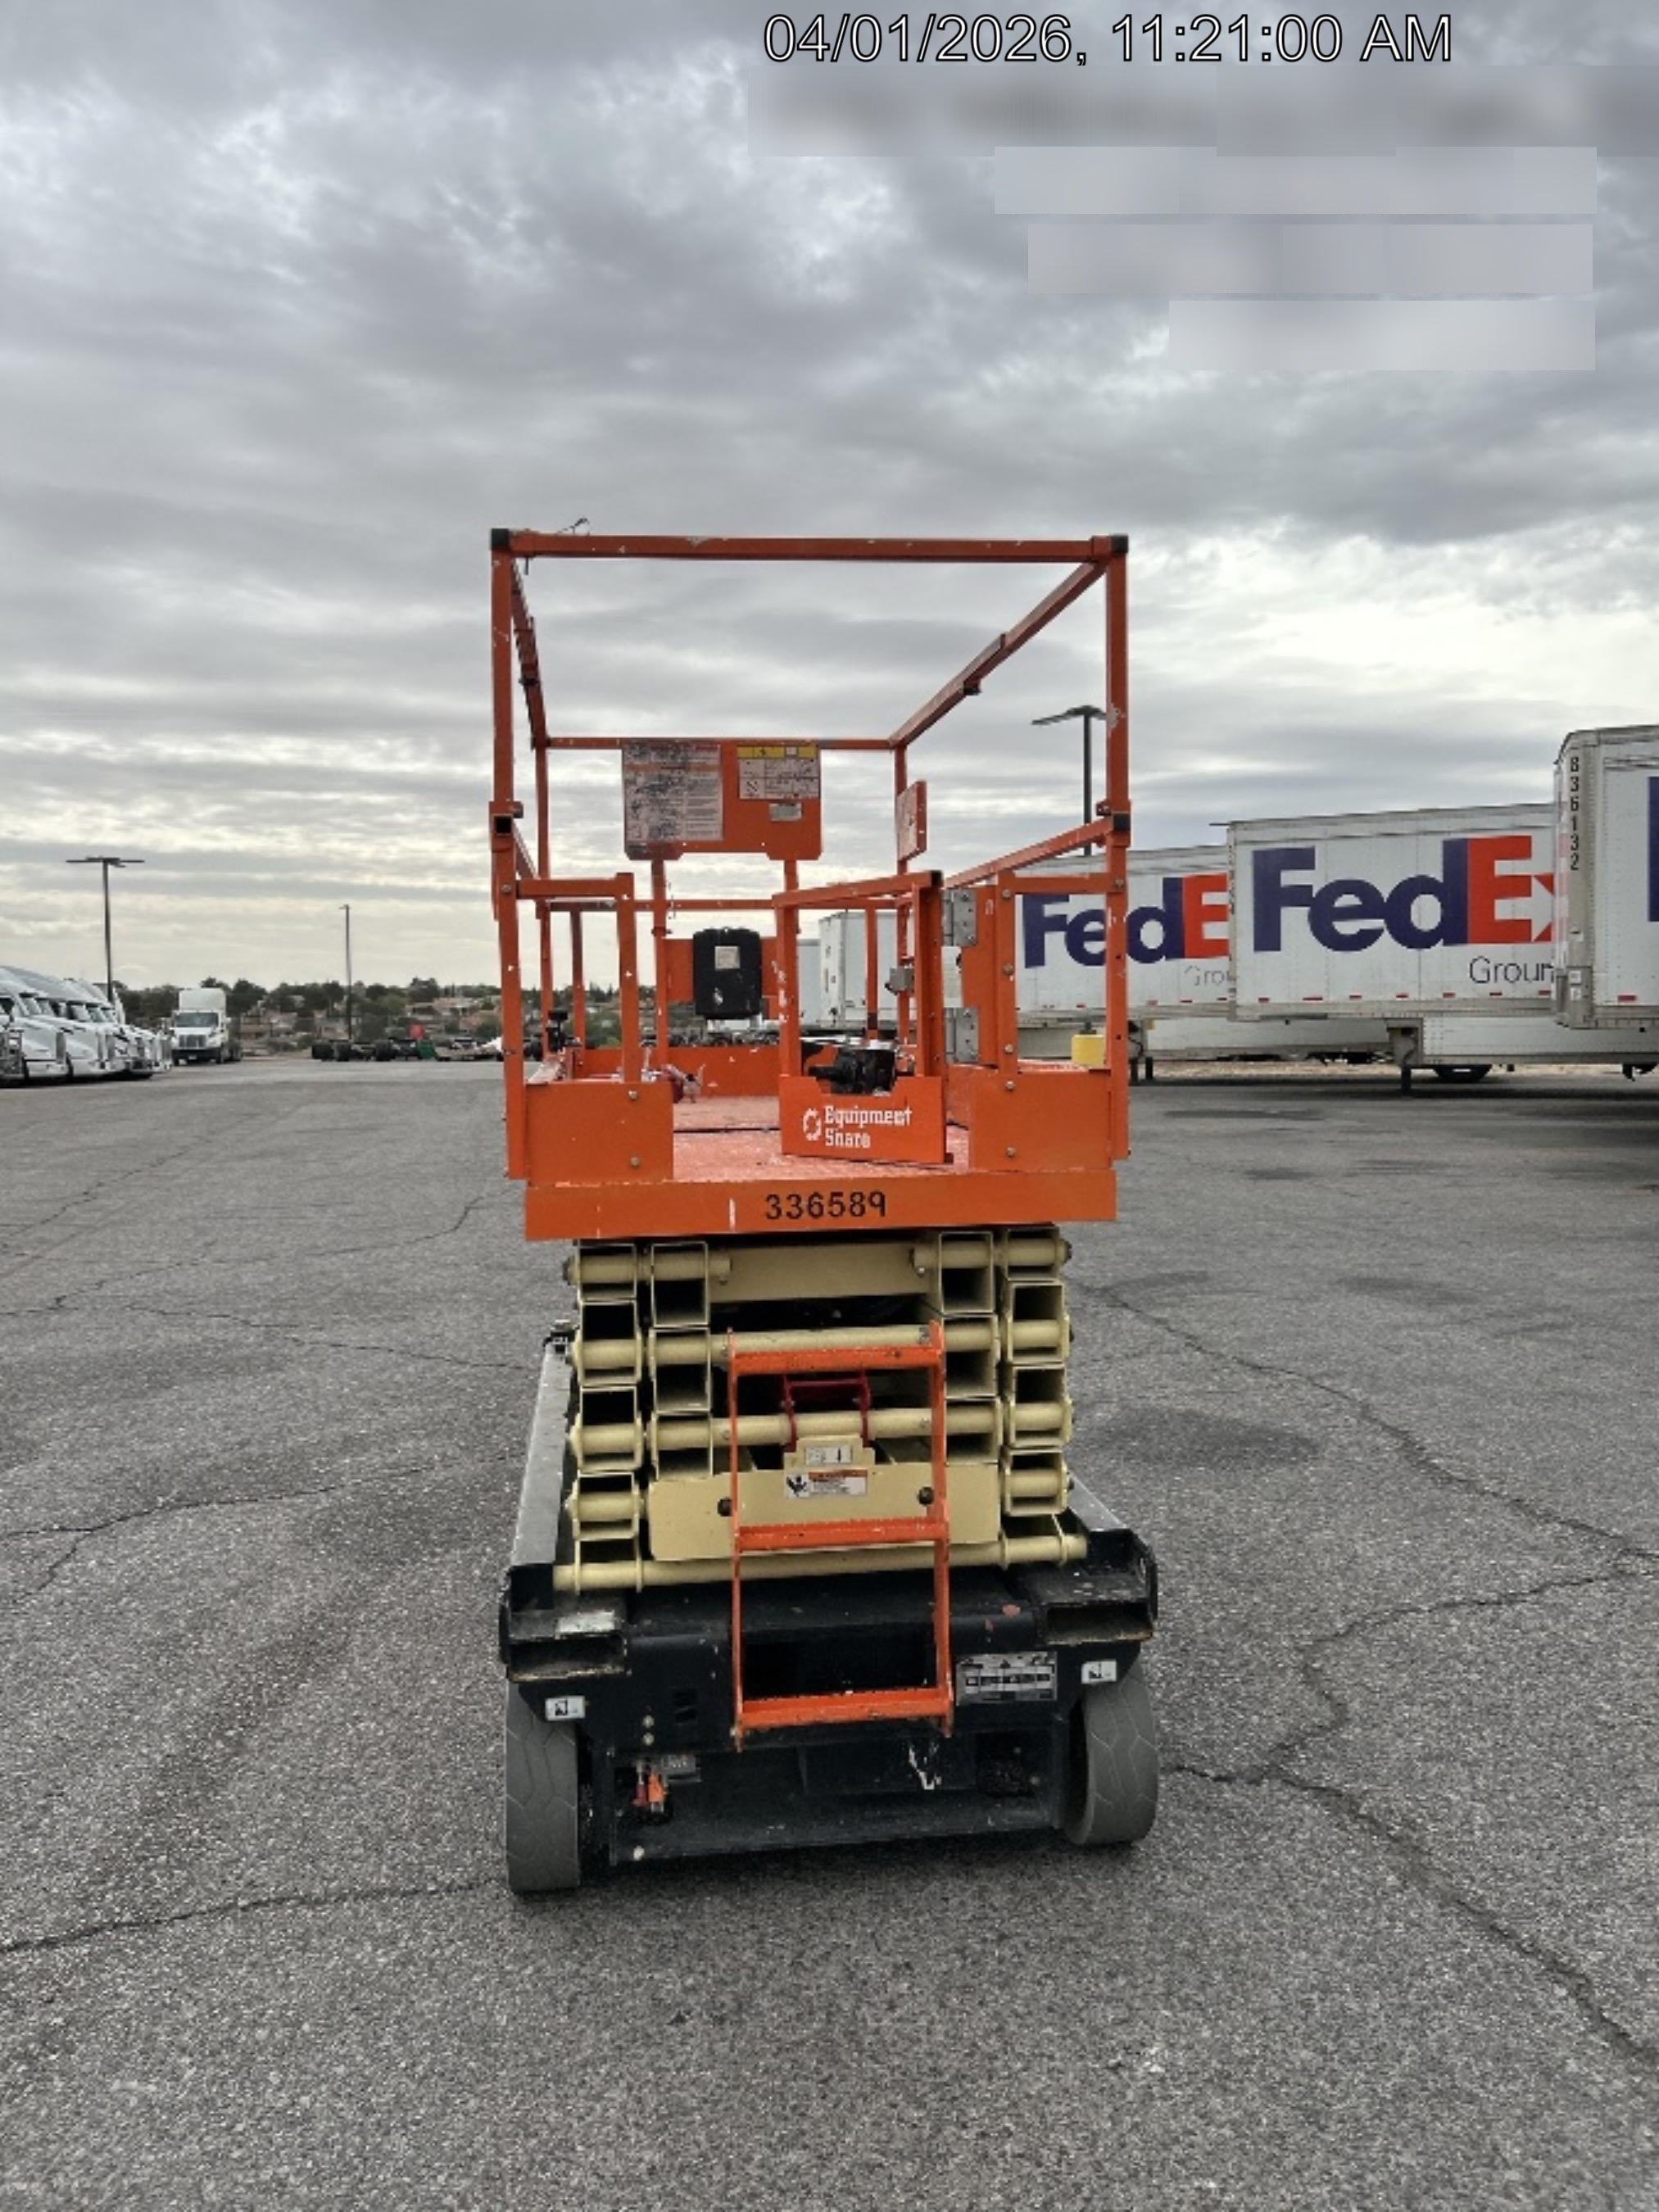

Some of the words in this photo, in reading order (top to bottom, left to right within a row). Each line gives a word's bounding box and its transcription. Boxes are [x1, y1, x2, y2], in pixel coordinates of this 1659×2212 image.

[1570, 756, 1580, 871] 836132
[825, 1105, 913, 1129] Equipment
[825, 1127, 871, 1149] Share
[764, 1190, 886, 1220] 336589
